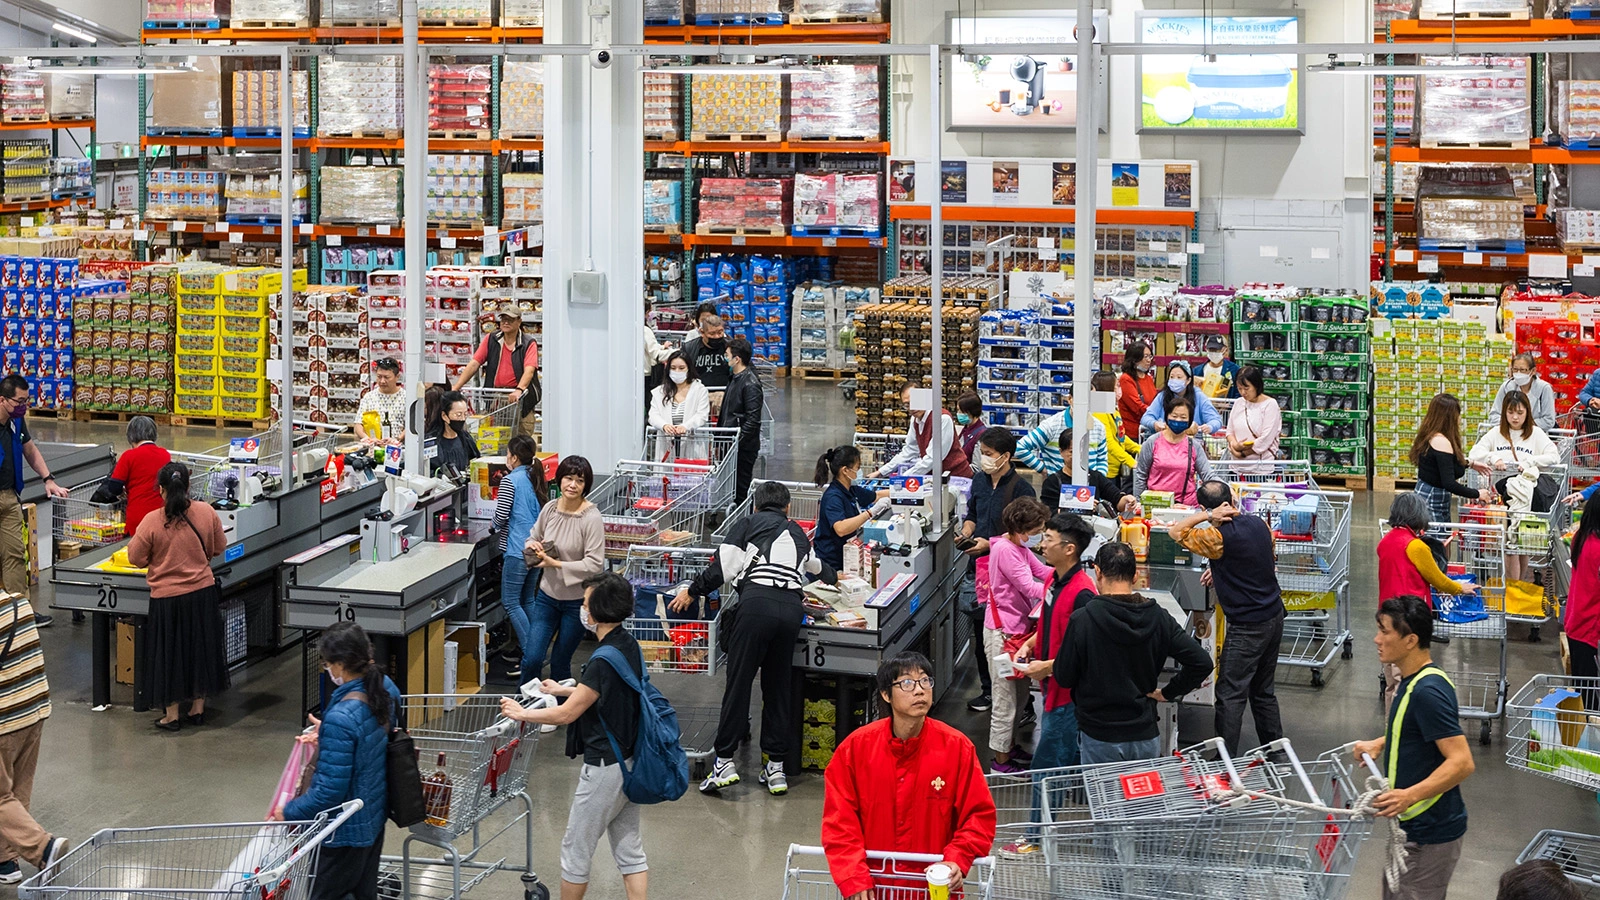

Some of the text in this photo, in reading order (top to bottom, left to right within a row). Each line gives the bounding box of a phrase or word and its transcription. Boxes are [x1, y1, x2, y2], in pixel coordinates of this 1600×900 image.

[98, 588, 117, 609] 20
[334, 606, 355, 622] 19
[801, 645, 825, 667] 18
